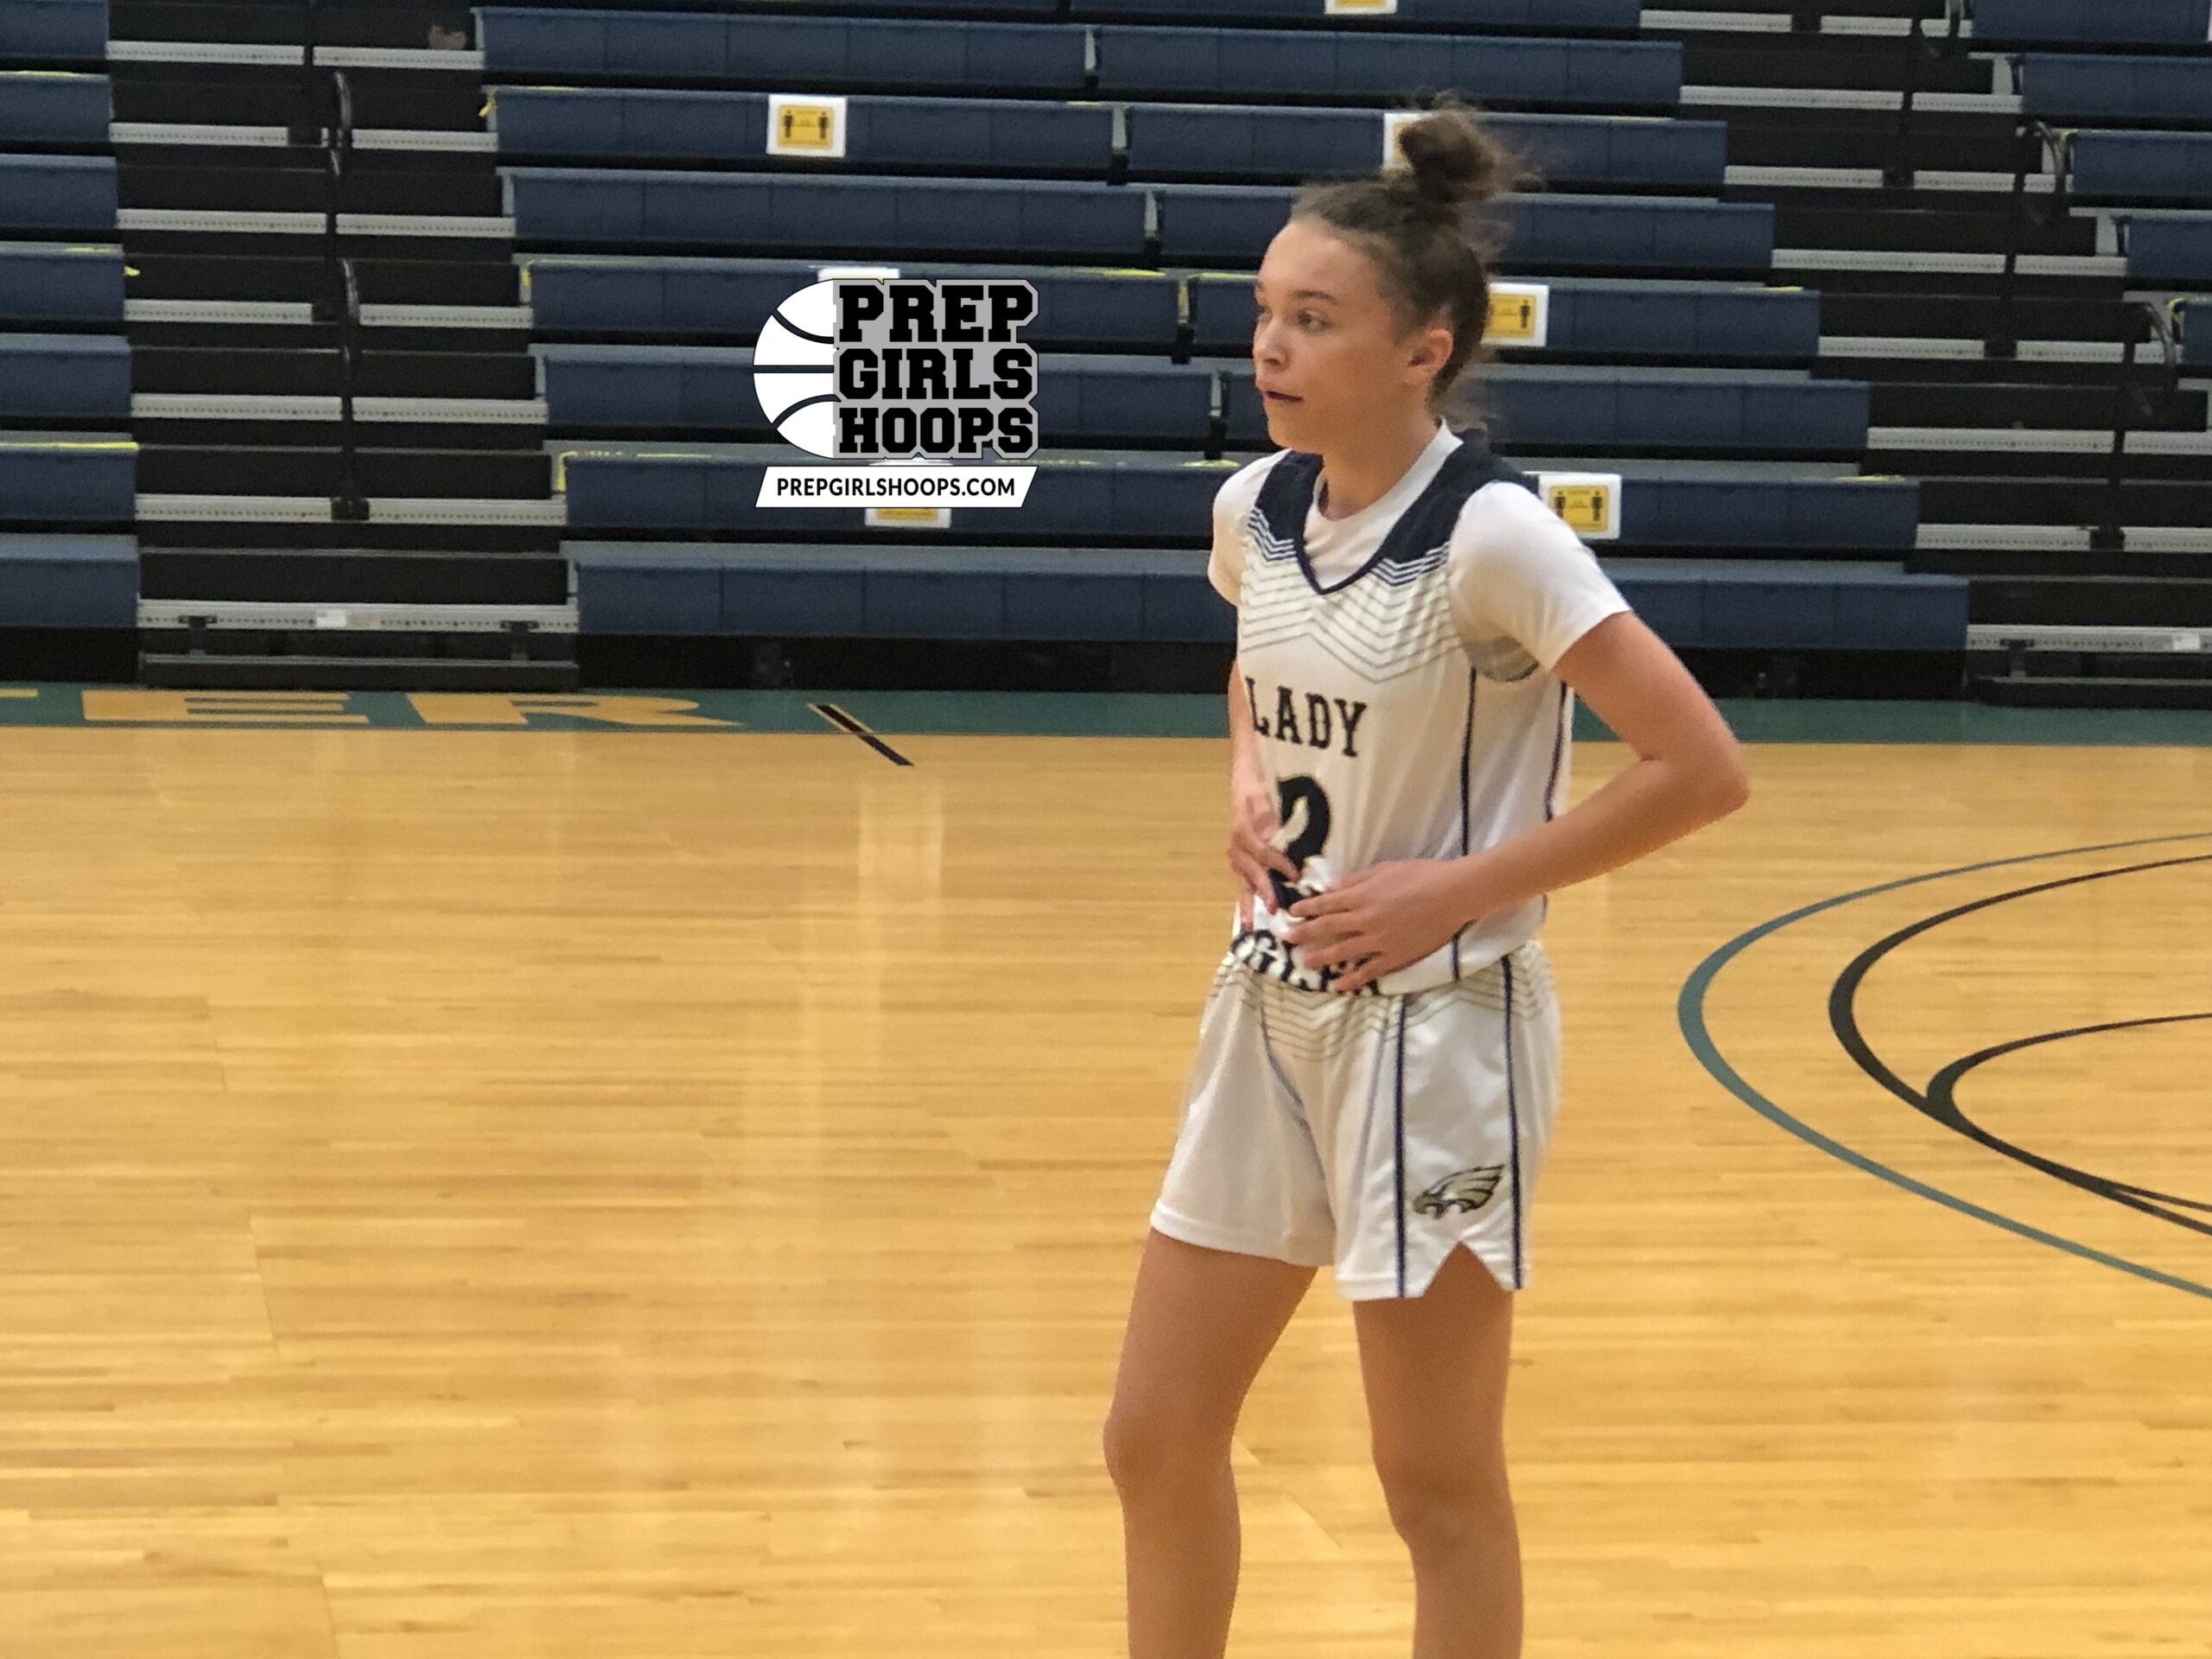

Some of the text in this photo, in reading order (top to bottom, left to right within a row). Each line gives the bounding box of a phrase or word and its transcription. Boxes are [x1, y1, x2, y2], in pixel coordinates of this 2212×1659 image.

[0, 690, 745, 727] ER
[1245, 677, 1368, 758] LADY
[1268, 774, 1331, 912] 2
